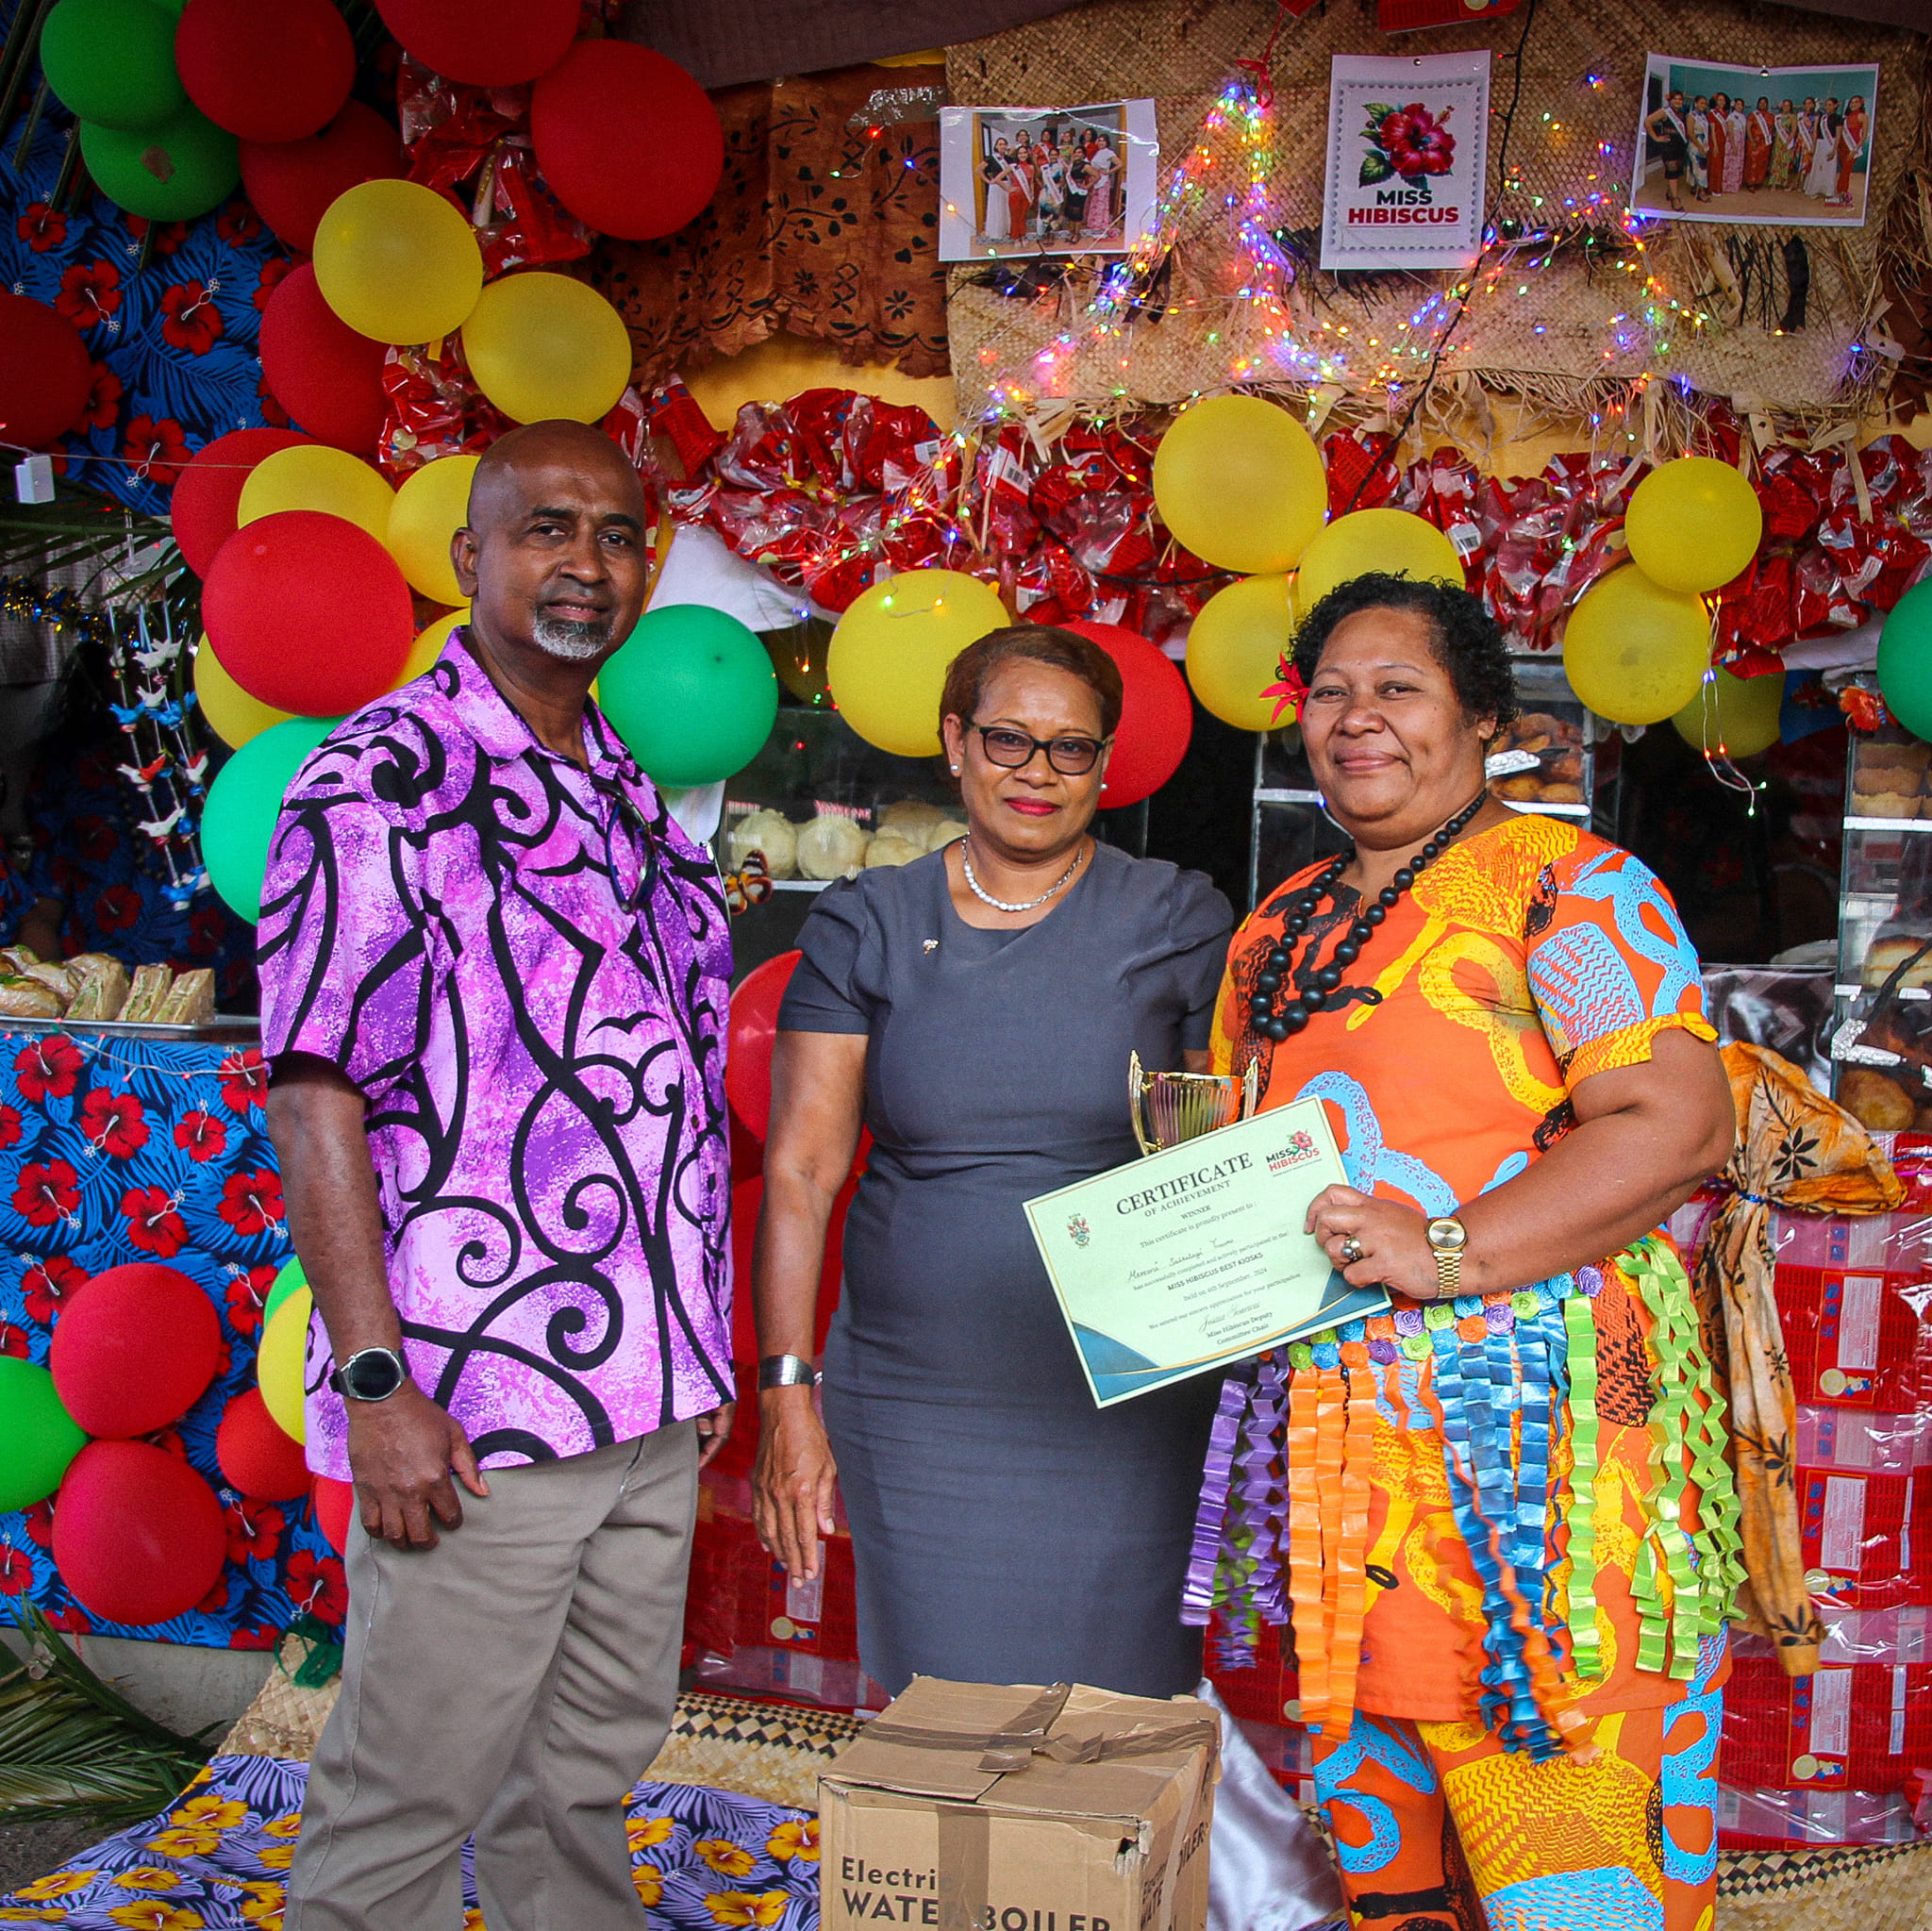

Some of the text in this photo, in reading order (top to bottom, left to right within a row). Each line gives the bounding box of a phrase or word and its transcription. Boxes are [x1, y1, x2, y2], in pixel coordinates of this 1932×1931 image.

[1375, 190, 1433, 206] MISS
[1348, 207, 1459, 225] HIBISCUS
[1265, 1147, 1292, 1163] MISS
[1269, 1147, 1320, 1172] HIBISCUS
[1116, 1153, 1252, 1214] CERTIFICATE
[1143, 1179, 1229, 1217] OF ACHIEVEMENT
[1180, 1205, 1210, 1219] WINNER
[1139, 1240, 1155, 1248] This
[1155, 1226, 1187, 1242] certificate
[1194, 1214, 1220, 1228] proudly
[1221, 1205, 1245, 1219] present
[1167, 1252, 1263, 1290] MISS HIBISCUS BEST KIOSKS
[1206, 1311, 1273, 1338] Miss Hibiscus Deputy
[1216, 1323, 1269, 1344] Committee Chair
